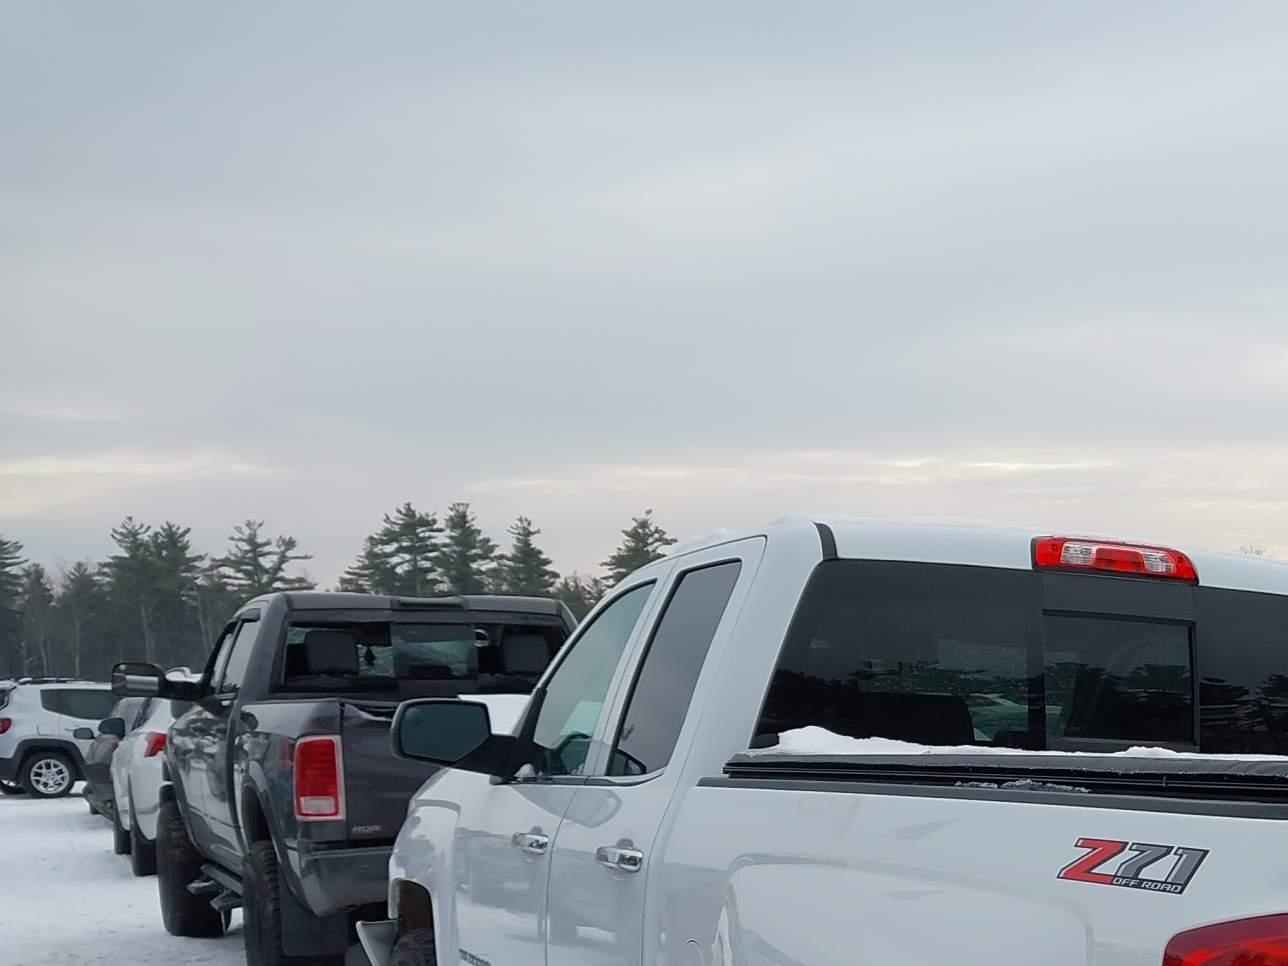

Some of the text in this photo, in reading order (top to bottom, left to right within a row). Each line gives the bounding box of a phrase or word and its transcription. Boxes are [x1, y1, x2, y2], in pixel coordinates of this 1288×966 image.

[1057, 837, 1209, 884] Z71
[1112, 877, 1183, 893] OFF ROAD
